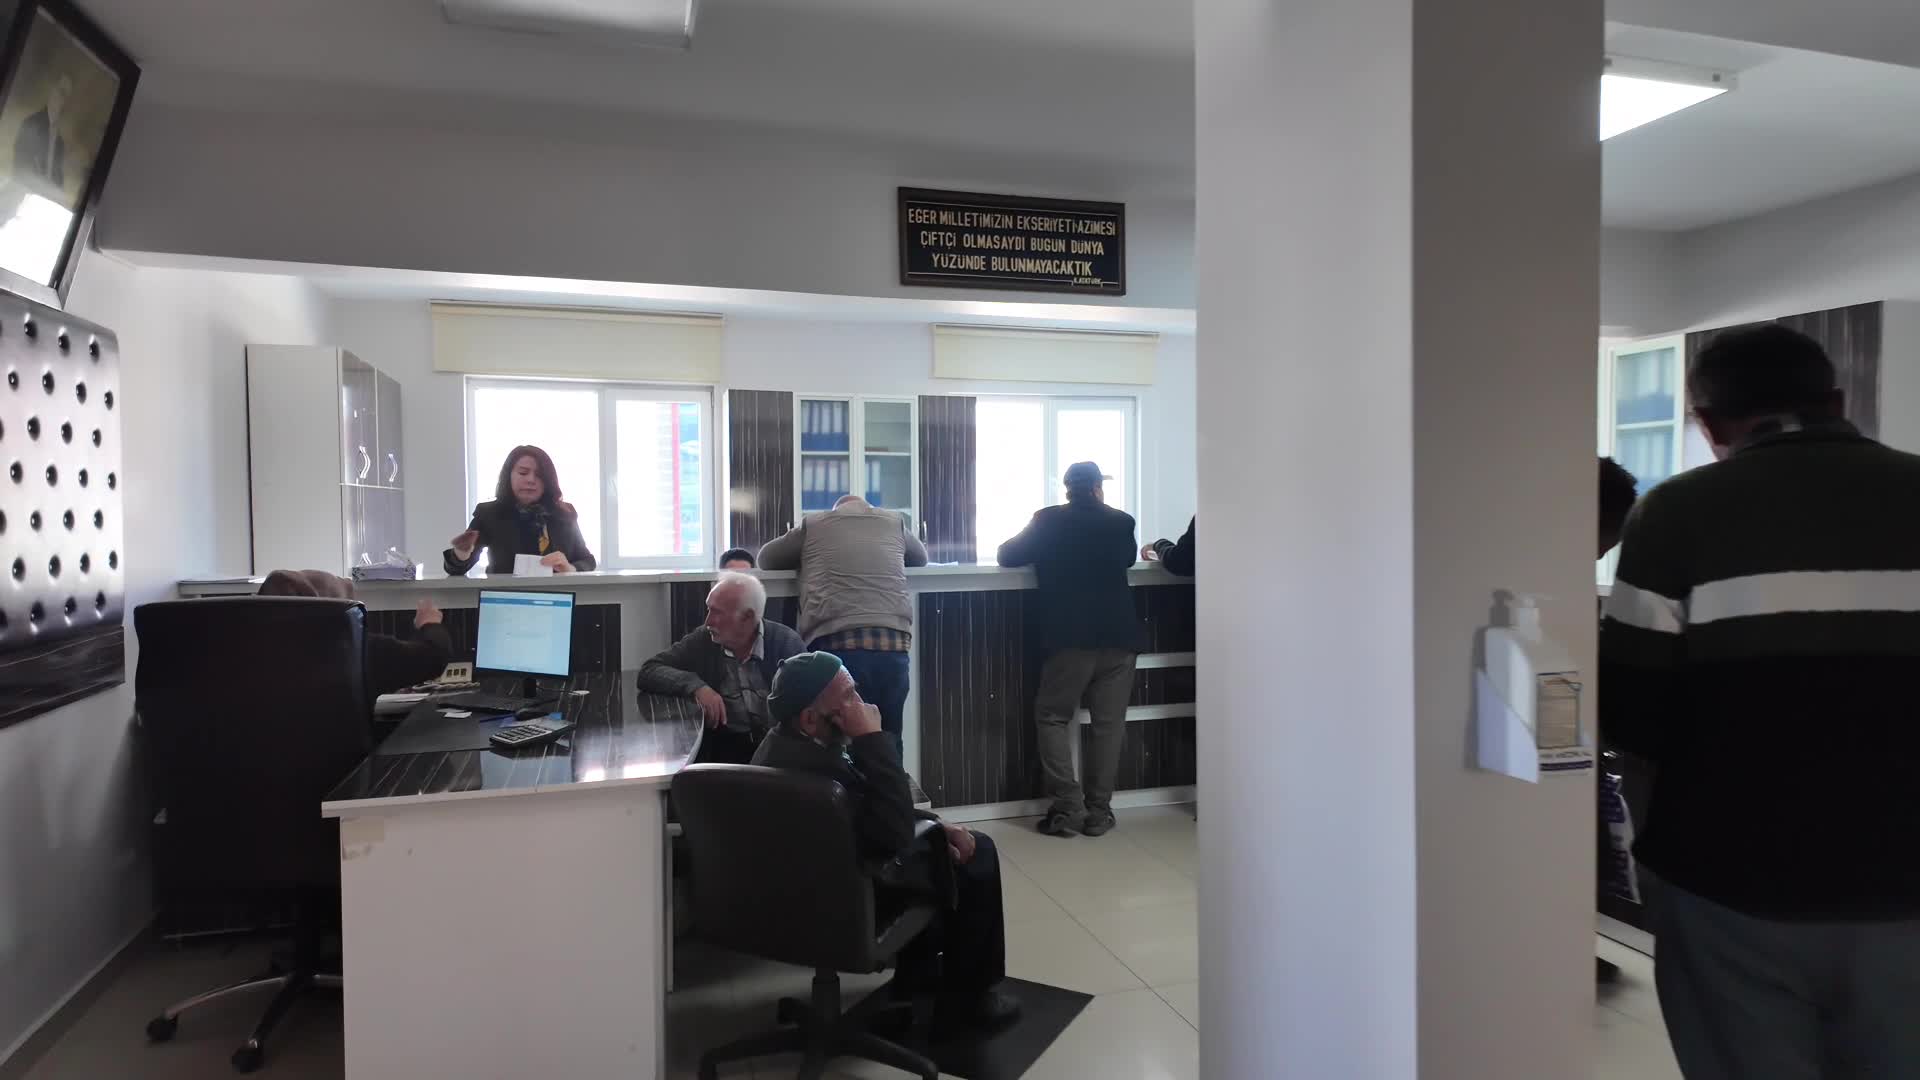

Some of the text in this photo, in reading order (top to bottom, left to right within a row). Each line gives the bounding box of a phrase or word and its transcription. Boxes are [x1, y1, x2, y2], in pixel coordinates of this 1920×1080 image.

[920, 230, 957, 249] ÇİFTÇİ
[963, 233, 1025, 251] OLMASAYDI
[1071, 239, 1105, 256] DÜNYA
[932, 253, 1093, 277] YÜZÜNDE BULUNMAYACAKTIK
